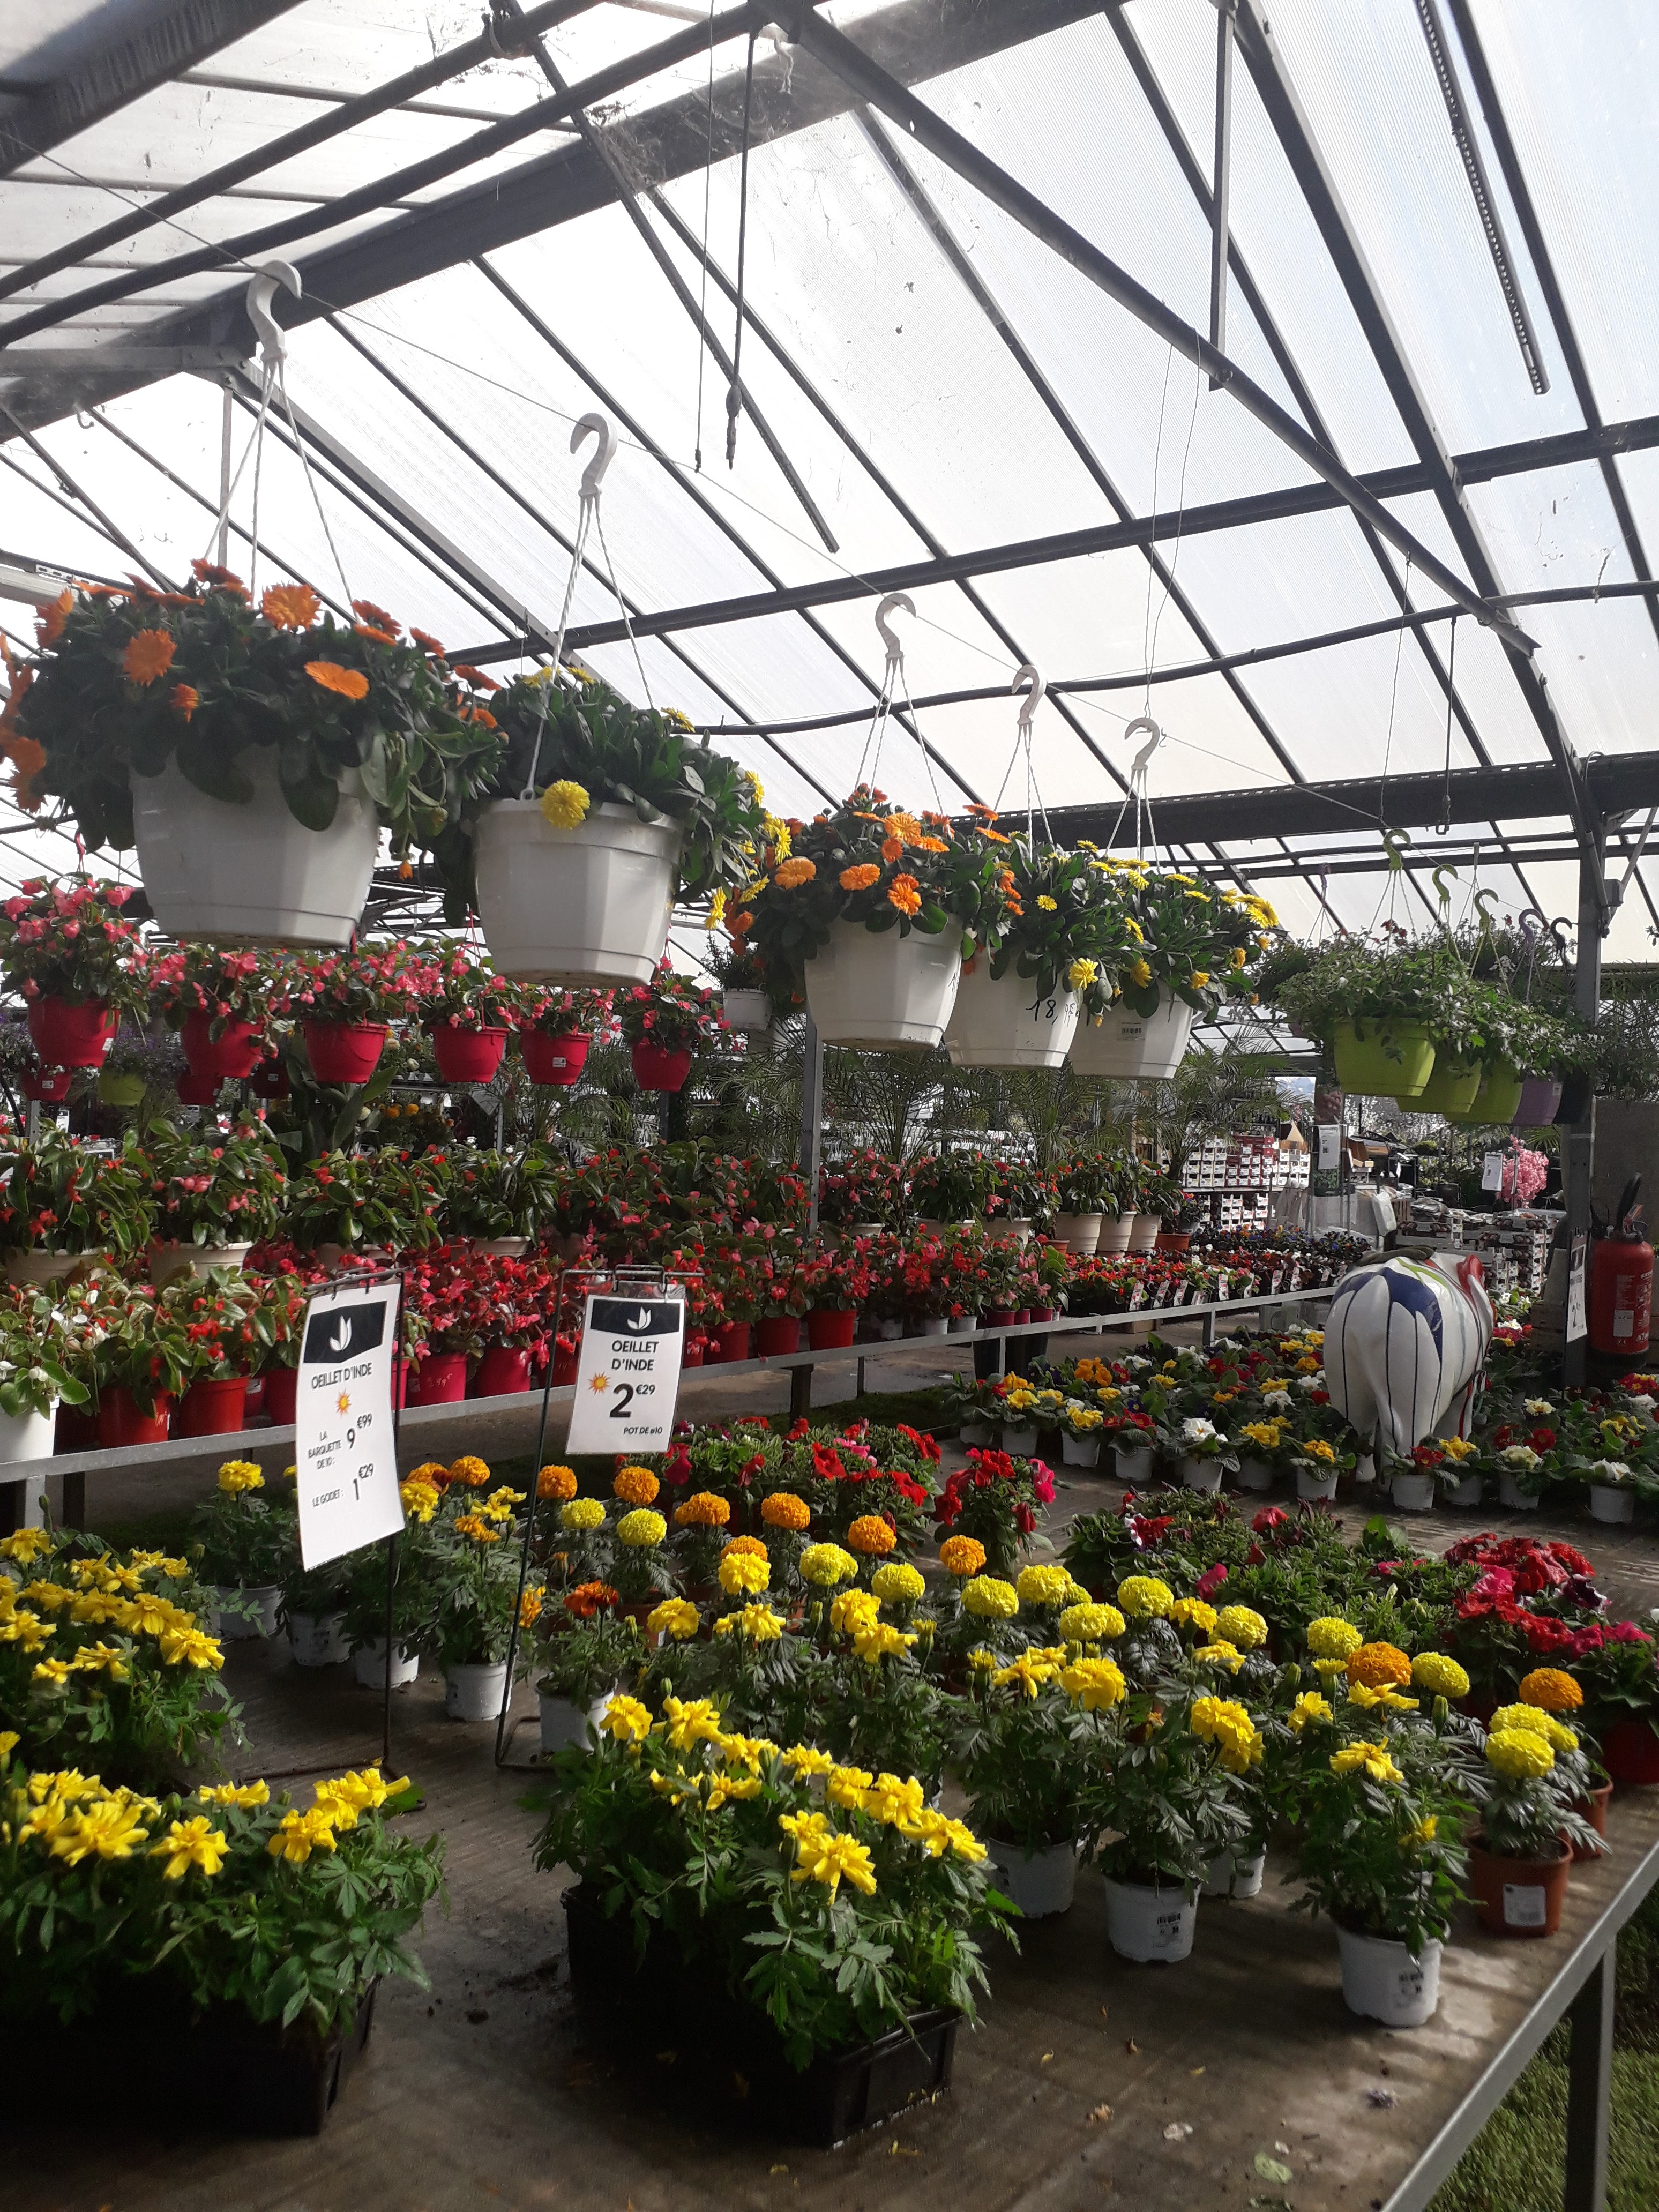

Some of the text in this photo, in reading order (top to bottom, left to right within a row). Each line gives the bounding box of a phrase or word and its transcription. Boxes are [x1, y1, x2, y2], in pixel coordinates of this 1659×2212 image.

[611, 1340, 660, 1353] OEILLET
[611, 1358, 654, 1371] D'INDE
[311, 1362, 372, 1389] OEILLET D'INDE
[319, 1430, 327, 1441] LA
[623, 1426, 639, 1434] POT
[308, 1439, 341, 1459] BARQUETTE
[312, 1496, 319, 1507] LE
